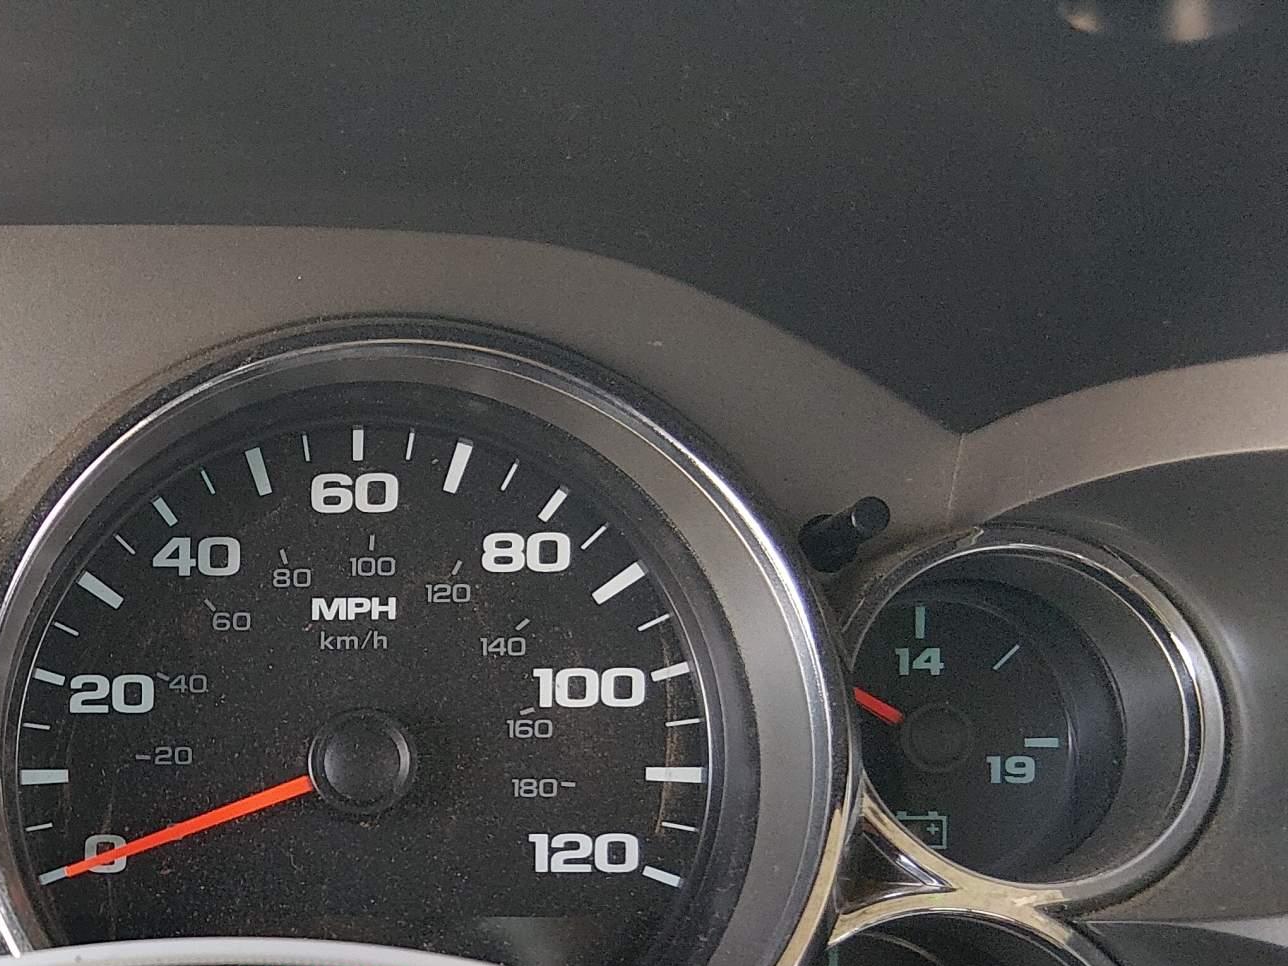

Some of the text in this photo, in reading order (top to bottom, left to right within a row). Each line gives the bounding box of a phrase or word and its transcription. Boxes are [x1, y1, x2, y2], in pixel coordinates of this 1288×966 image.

[311, 473, 399, 513] 60
[152, 536, 241, 576] 40
[482, 532, 571, 572] 80
[349, 556, 396, 577] 100
[272, 568, 311, 588] 80
[425, 583, 471, 603] 120
[311, 597, 397, 620] MPH
[212, 611, 251, 631] 60
[319, 631, 388, 651] km/h
[480, 636, 526, 657] 140
[895, 647, 944, 676] 14
[69, 673, 155, 714] 20
[169, 674, 208, 694] 40
[532, 667, 645, 707] 100
[506, 719, 553, 739] 160
[154, 745, 193, 765] 20
[986, 756, 1035, 784] 19
[512, 778, 558, 798] 180
[84, 834, 127, 873] 0
[528, 833, 639, 873] 120
